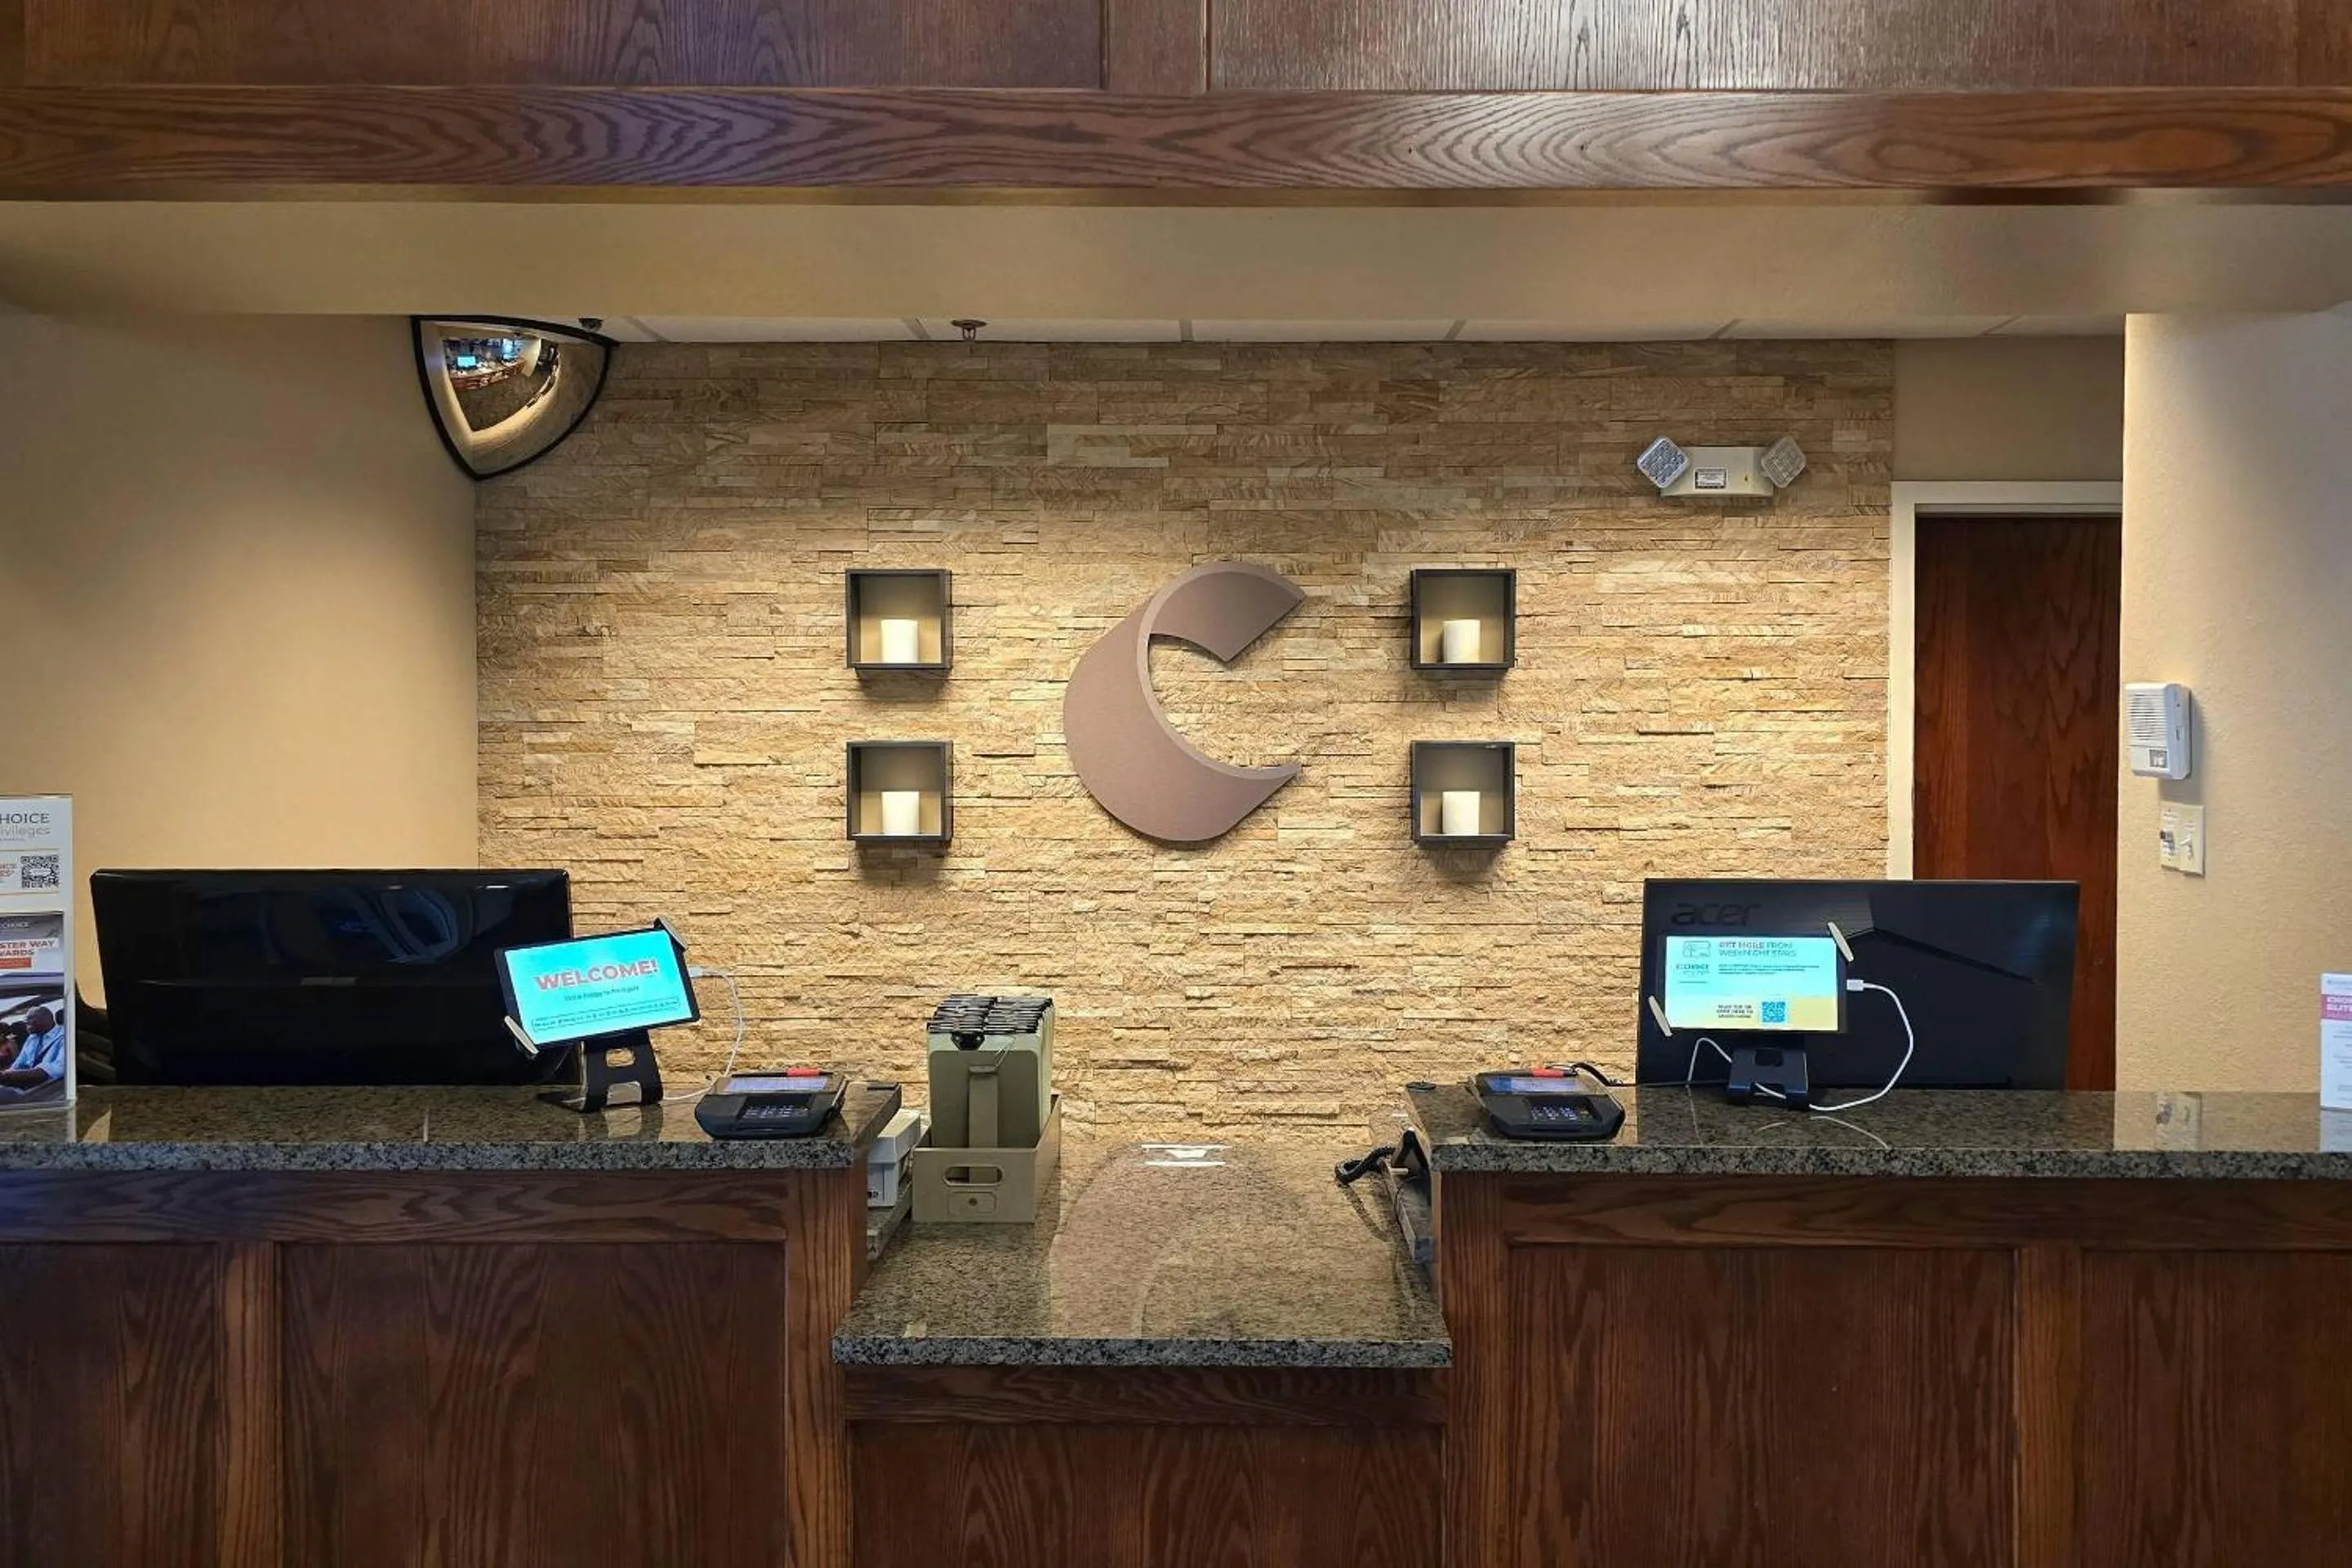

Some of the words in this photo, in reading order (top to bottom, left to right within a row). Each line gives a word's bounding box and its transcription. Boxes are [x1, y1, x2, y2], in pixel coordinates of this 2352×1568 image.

[1670, 902, 1763, 926] acer
[29, 940, 55, 948] WAY
[535, 959, 659, 991] WELCOME!
